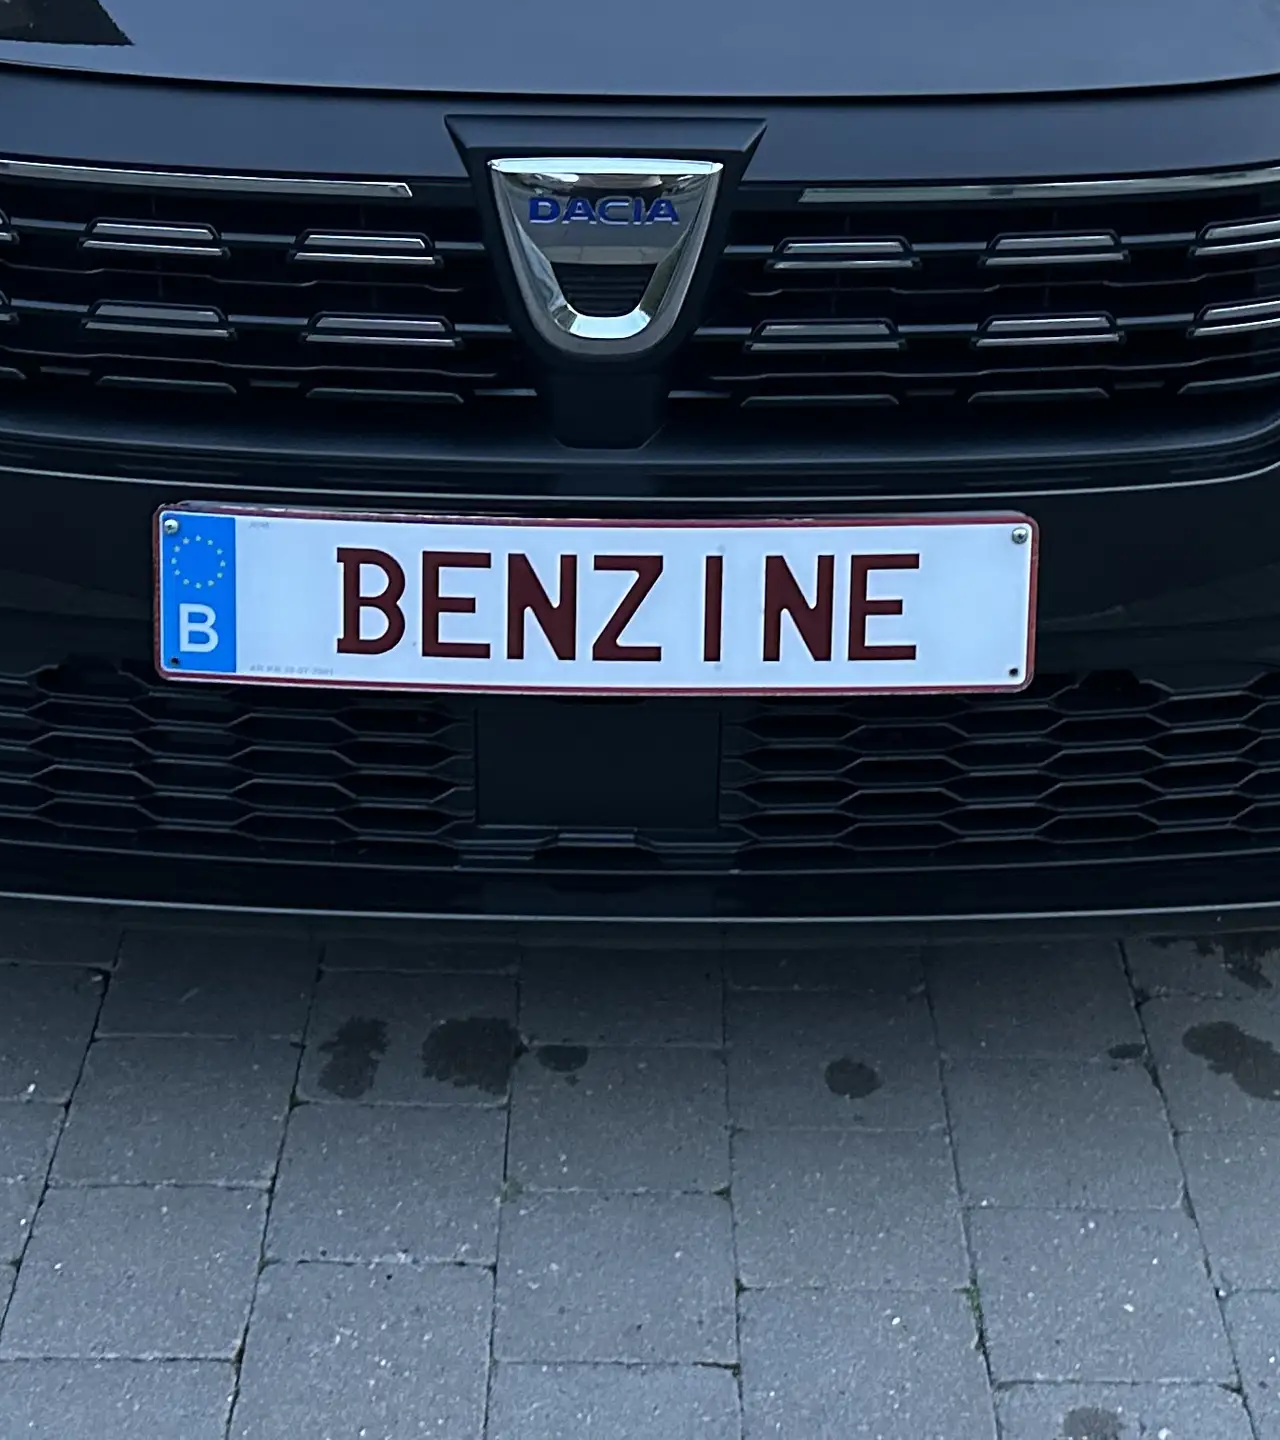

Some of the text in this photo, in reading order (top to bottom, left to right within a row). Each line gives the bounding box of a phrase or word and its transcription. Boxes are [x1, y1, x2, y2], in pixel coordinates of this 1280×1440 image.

[528, 196, 680, 225] DACIA
[179, 603, 219, 653] B
[335, 546, 921, 663] BENZINE
